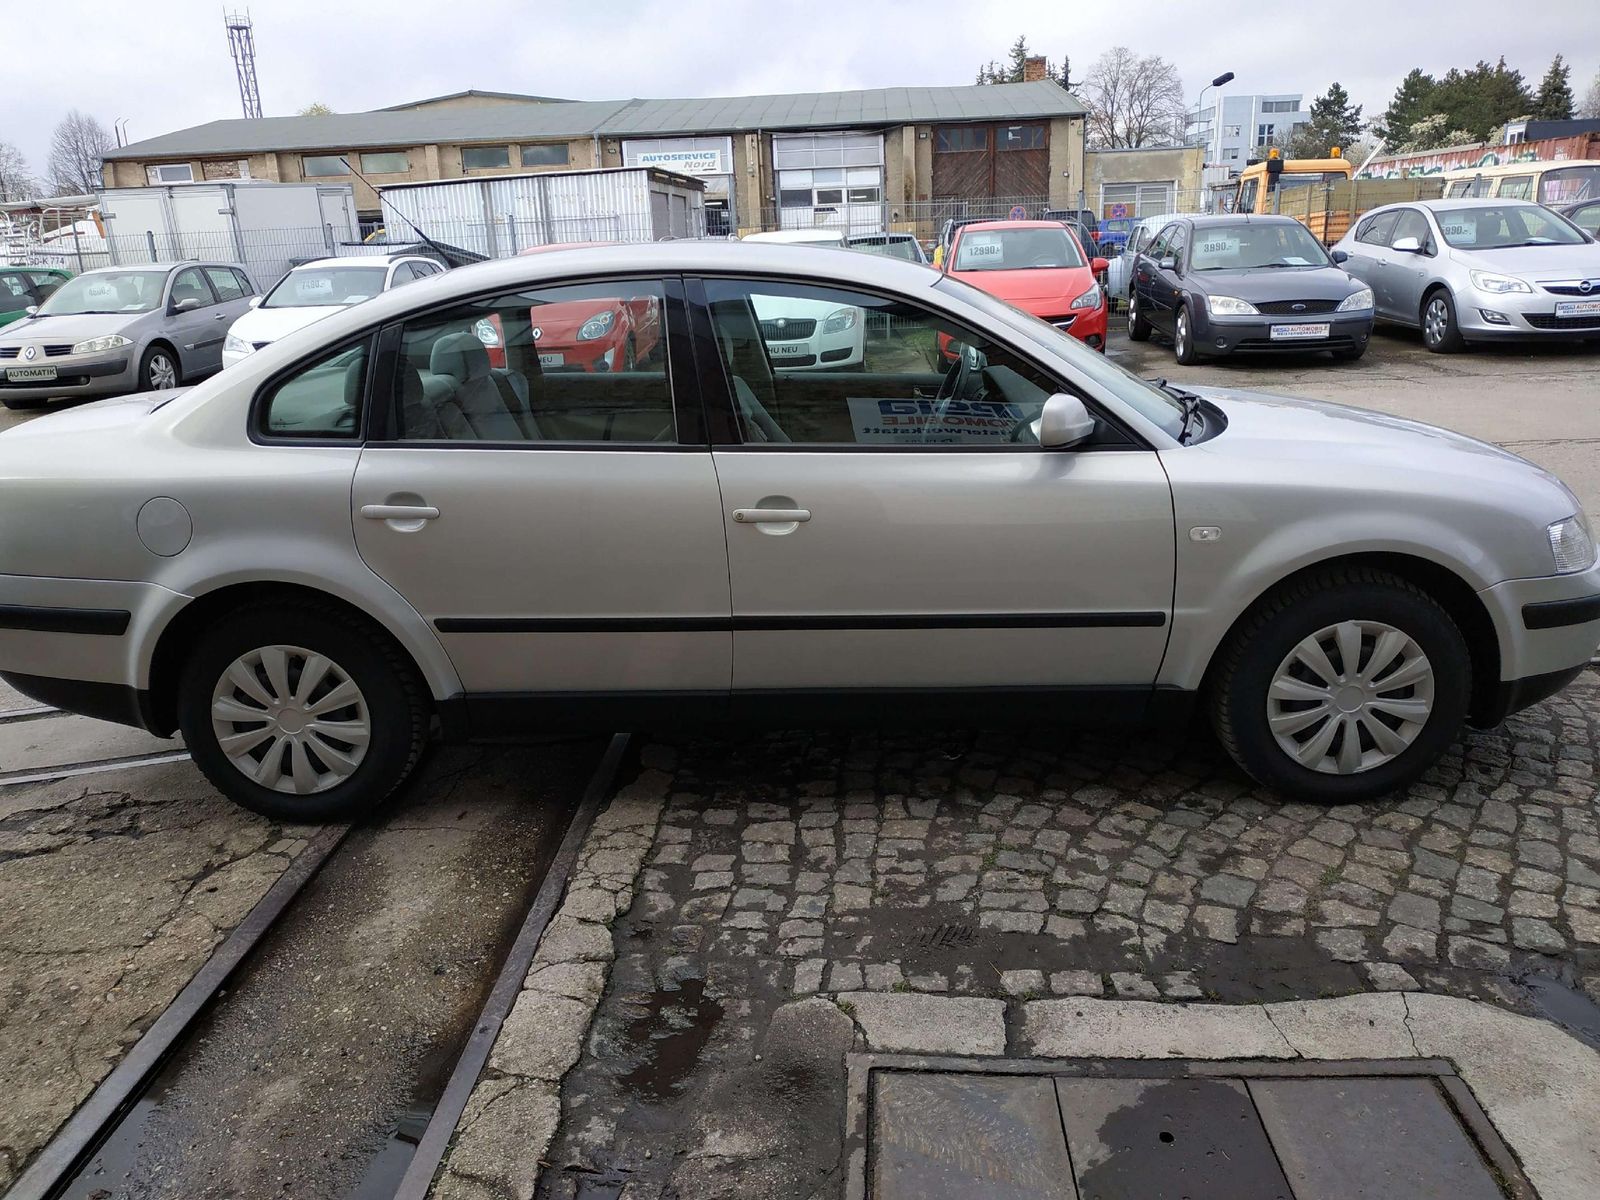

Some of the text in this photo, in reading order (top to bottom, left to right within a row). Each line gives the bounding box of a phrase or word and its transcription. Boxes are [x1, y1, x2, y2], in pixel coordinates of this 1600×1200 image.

[642, 152, 716, 162] AUTOSERVICE
[684, 160, 716, 169] Nord
[781, 346, 798, 354] NEU
[8, 368, 56, 378] AUTOMATIK
